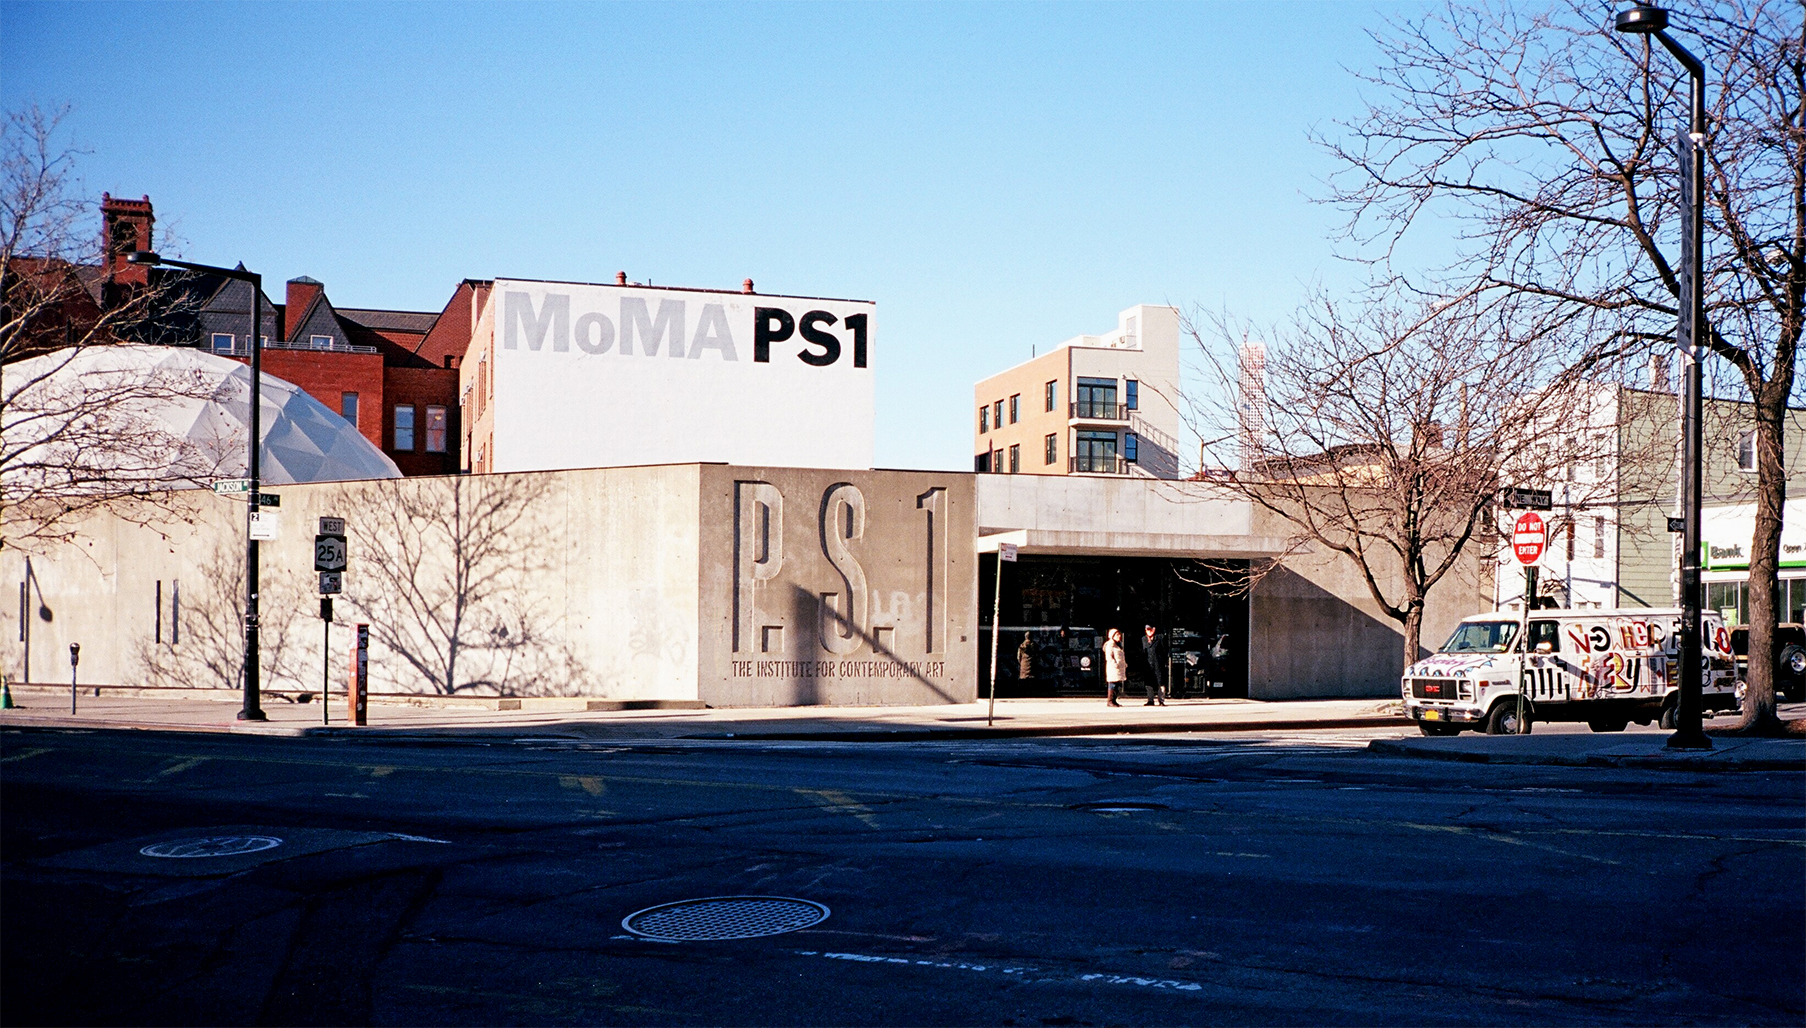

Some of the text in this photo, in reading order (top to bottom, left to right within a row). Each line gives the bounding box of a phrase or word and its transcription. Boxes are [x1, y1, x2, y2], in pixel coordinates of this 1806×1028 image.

[504, 291, 868, 369] MoMA PS1
[216, 481, 242, 493] JACKSON
[253, 513, 258, 521] 2
[323, 520, 341, 532] WEST
[1517, 522, 1541, 531] DO NOT
[317, 545, 343, 562] 25A
[1518, 546, 1538, 555] ENTER
[1710, 544, 1743, 559] Bank
[1783, 543, 1802, 554] Open
[732, 660, 945, 678] THE INSTITUTE FOR CONTEMPORARY ART
